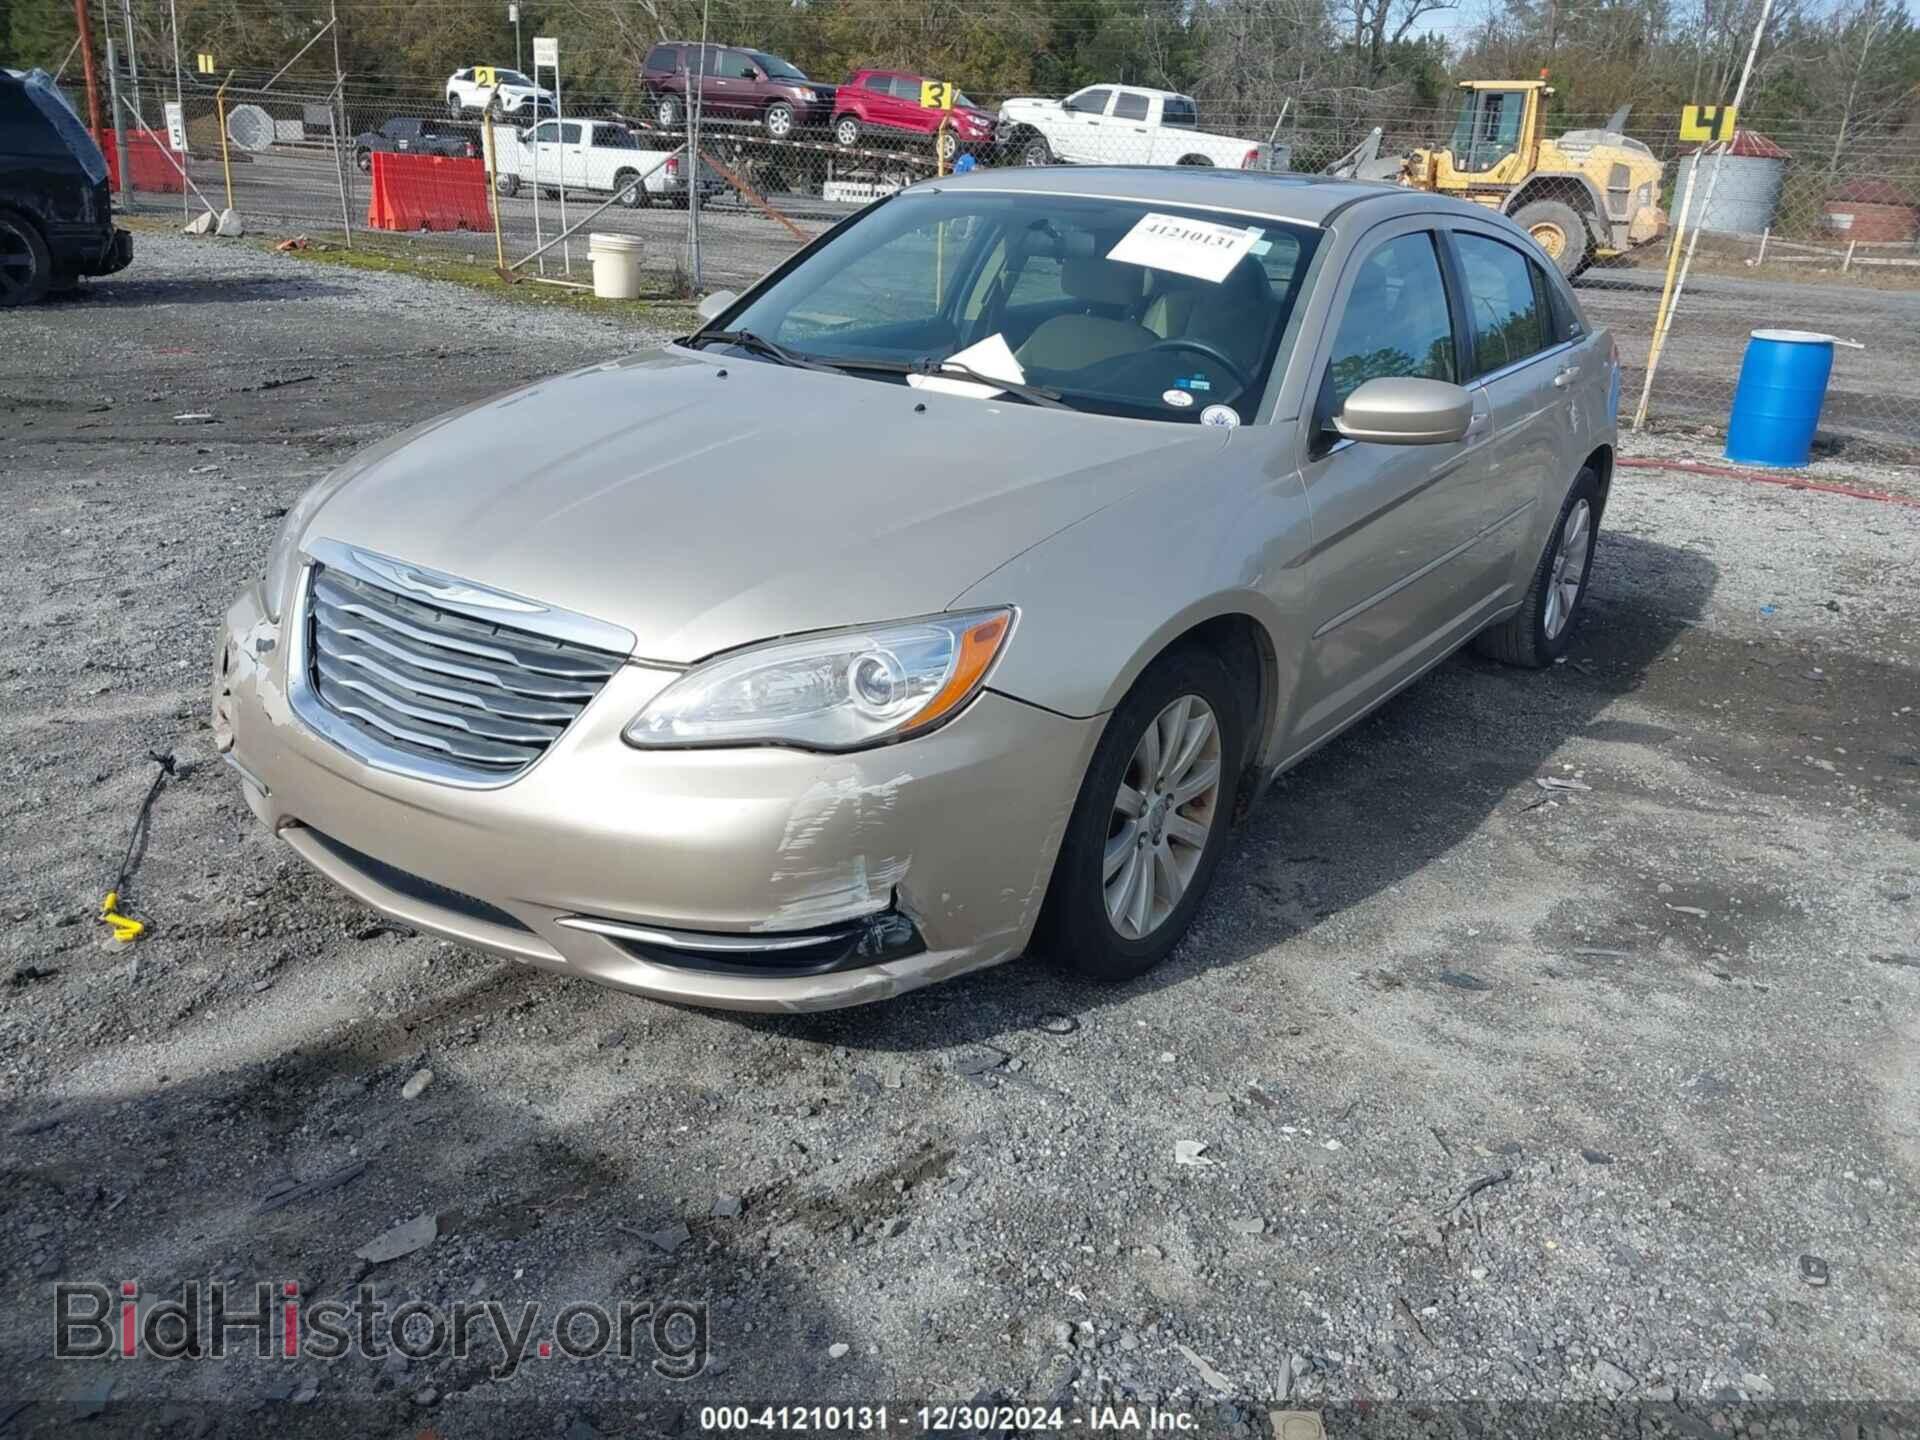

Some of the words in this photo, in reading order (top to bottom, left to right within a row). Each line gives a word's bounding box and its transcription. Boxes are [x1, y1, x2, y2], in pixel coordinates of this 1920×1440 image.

[477, 70, 490, 88] 2
[928, 82, 945, 108] 3
[1696, 106, 1725, 140] 4
[173, 129, 181, 146] 5
[1145, 223, 1236, 249] 41210131
